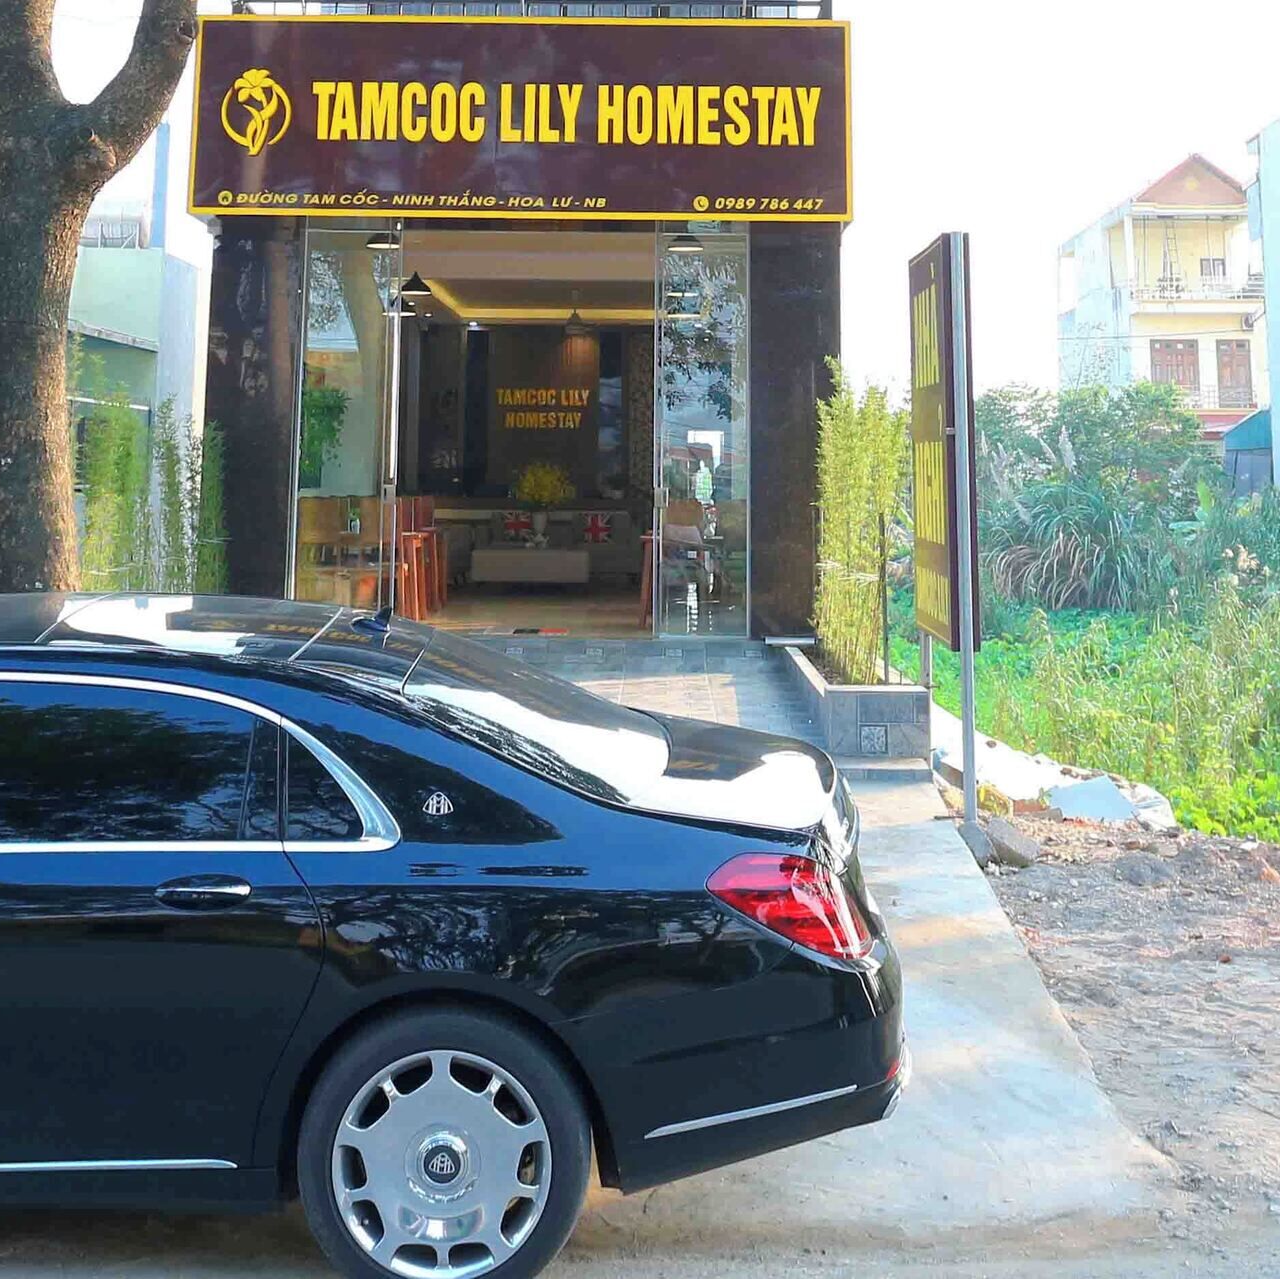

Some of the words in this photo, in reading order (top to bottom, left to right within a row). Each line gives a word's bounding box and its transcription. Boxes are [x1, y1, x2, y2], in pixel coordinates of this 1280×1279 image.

[312, 81, 487, 143] TAMCOC
[499, 83, 584, 144] LILY
[596, 84, 822, 147] HOMESTAY
[236, 190, 298, 205] ĐƯỜNG
[303, 194, 336, 205] TAM
[339, 188, 380, 206] CỐC
[392, 194, 435, 207] NINH
[438, 190, 497, 207] THẮNG
[508, 196, 546, 208] HOA
[552, 196, 574, 208] LƯ
[584, 198, 607, 208] NB
[714, 197, 756, 210] 0989
[760, 198, 790, 211] 786
[793, 198, 824, 211] 447
[496, 388, 557, 406] TAMCOC
[560, 388, 590, 407] LILY
[505, 411, 582, 429] HOMESTAY
